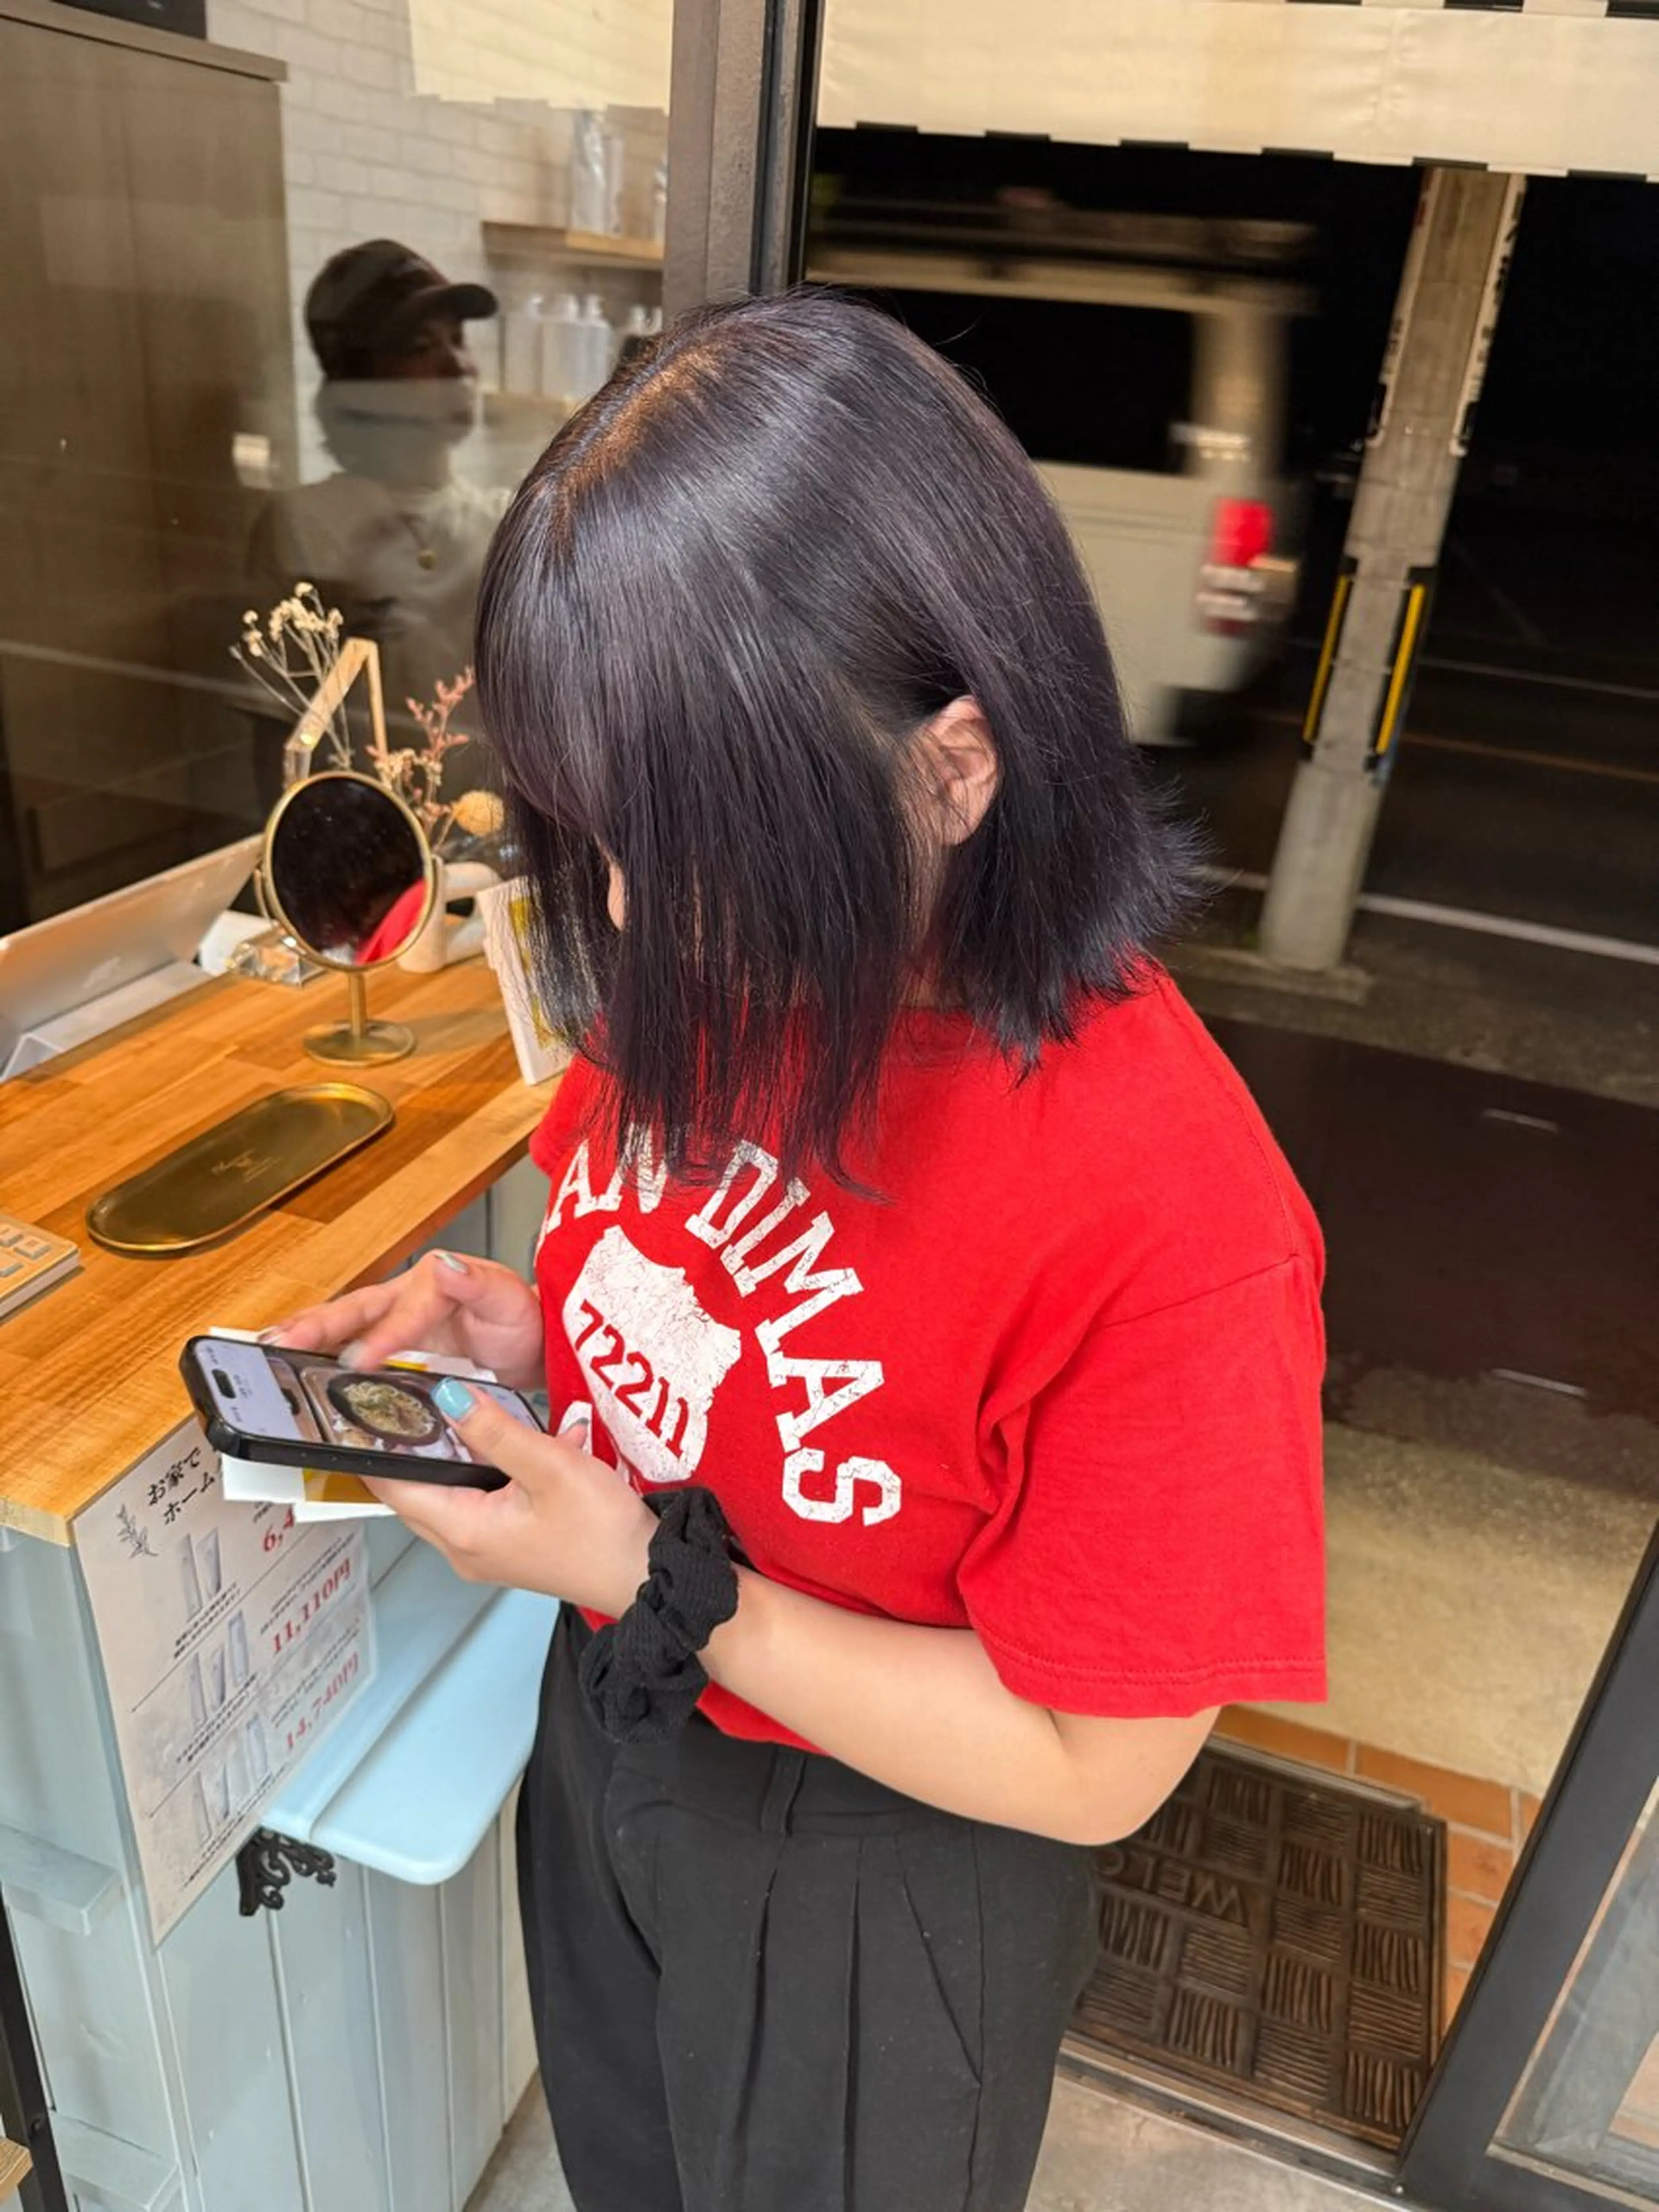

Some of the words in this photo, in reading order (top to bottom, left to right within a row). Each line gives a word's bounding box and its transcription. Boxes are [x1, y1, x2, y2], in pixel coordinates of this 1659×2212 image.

[534, 1121, 668, 1267] AN
[685, 1139, 902, 1526] DIMAS
[575, 1299, 689, 1459] 72211
[148, 1447, 201, 1506] お家で
[164, 1457, 222, 1525] ホーム
[274, 1557, 350, 1653] 11,110円
